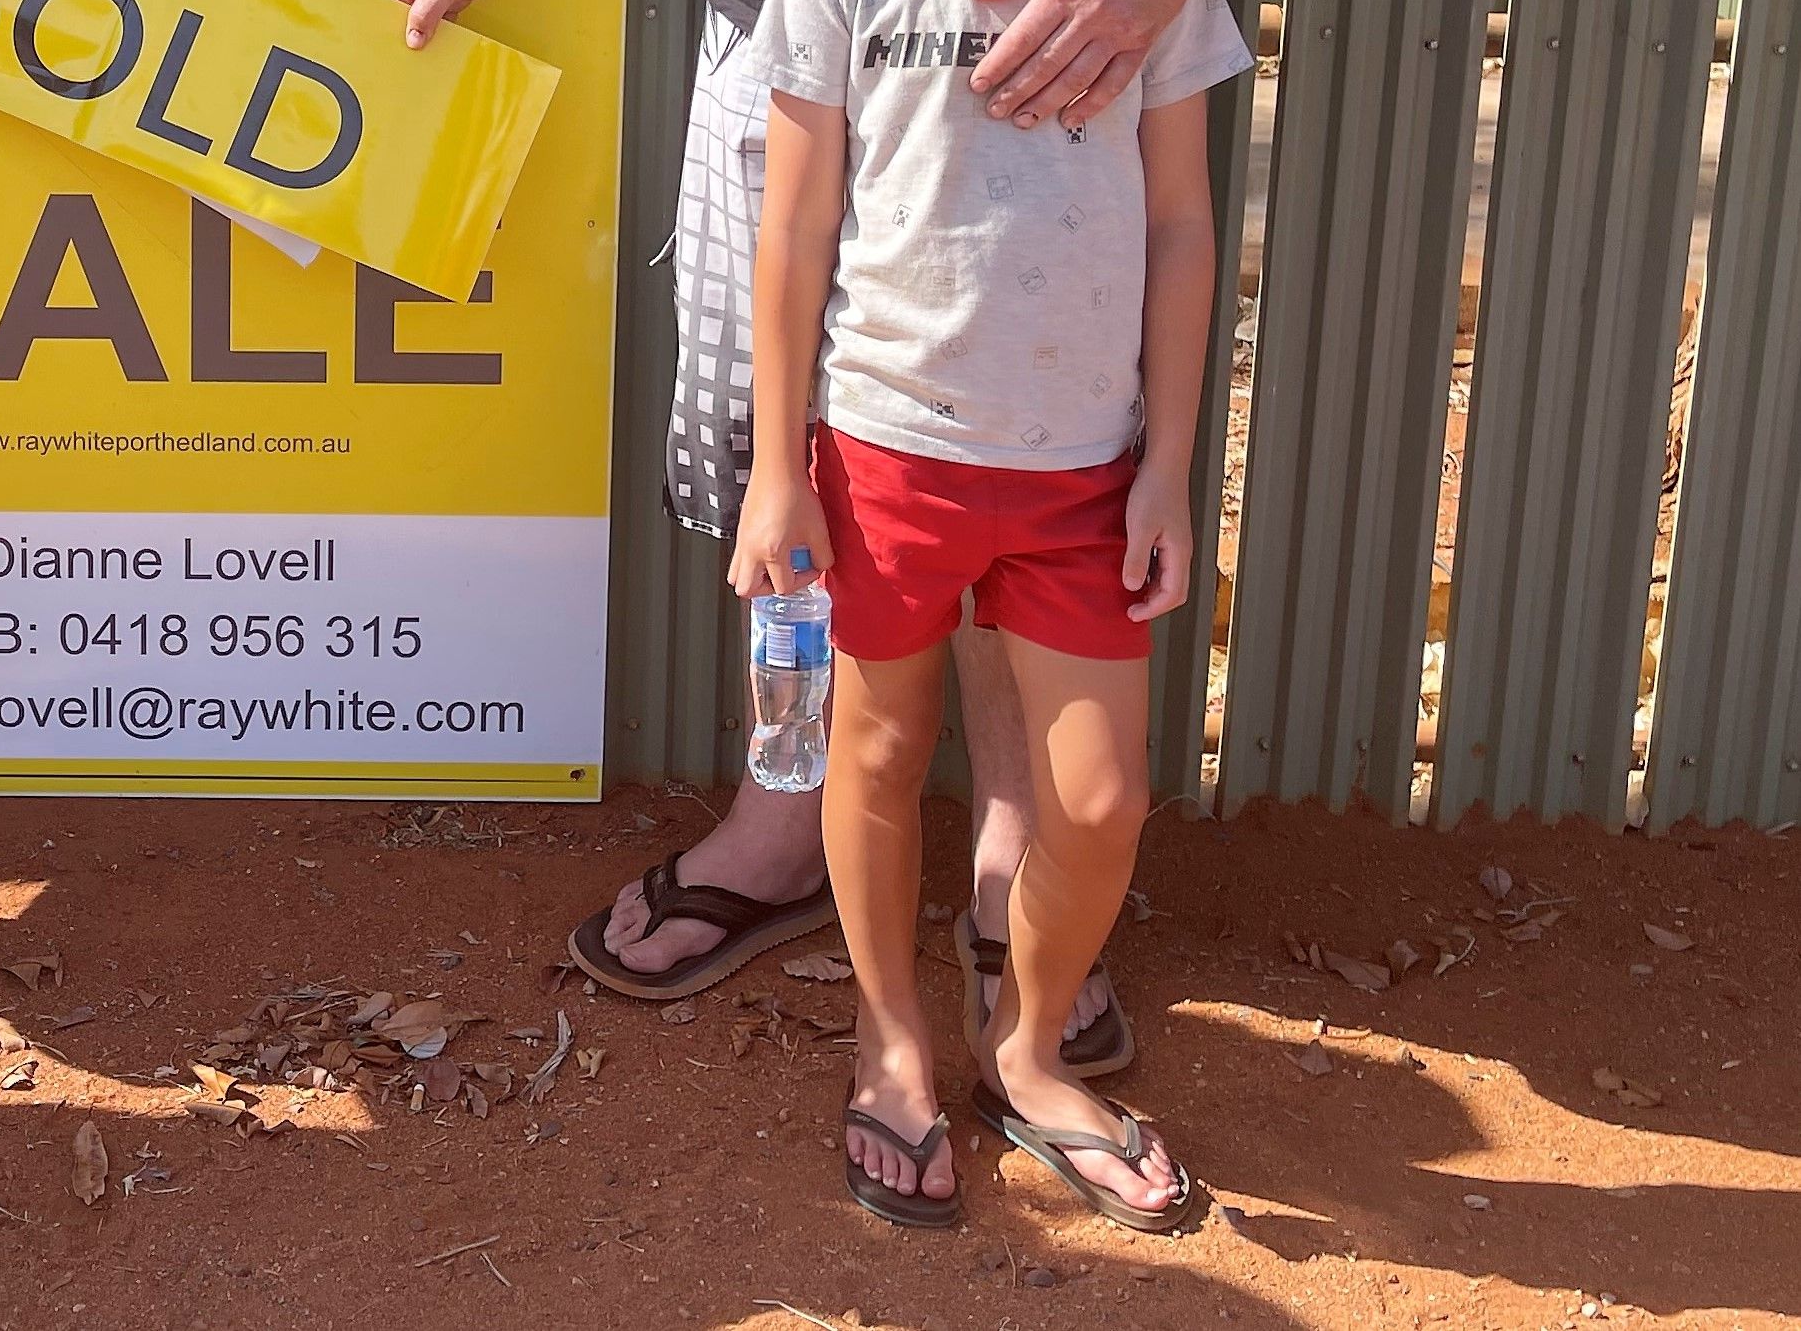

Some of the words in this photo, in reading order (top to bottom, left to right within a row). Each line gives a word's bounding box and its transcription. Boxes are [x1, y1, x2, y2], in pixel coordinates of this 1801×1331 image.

[184, 537, 335, 582] Lovell
[59, 611, 189, 658] 0418
[209, 612, 305, 658] 956
[325, 613, 422, 659] 315
